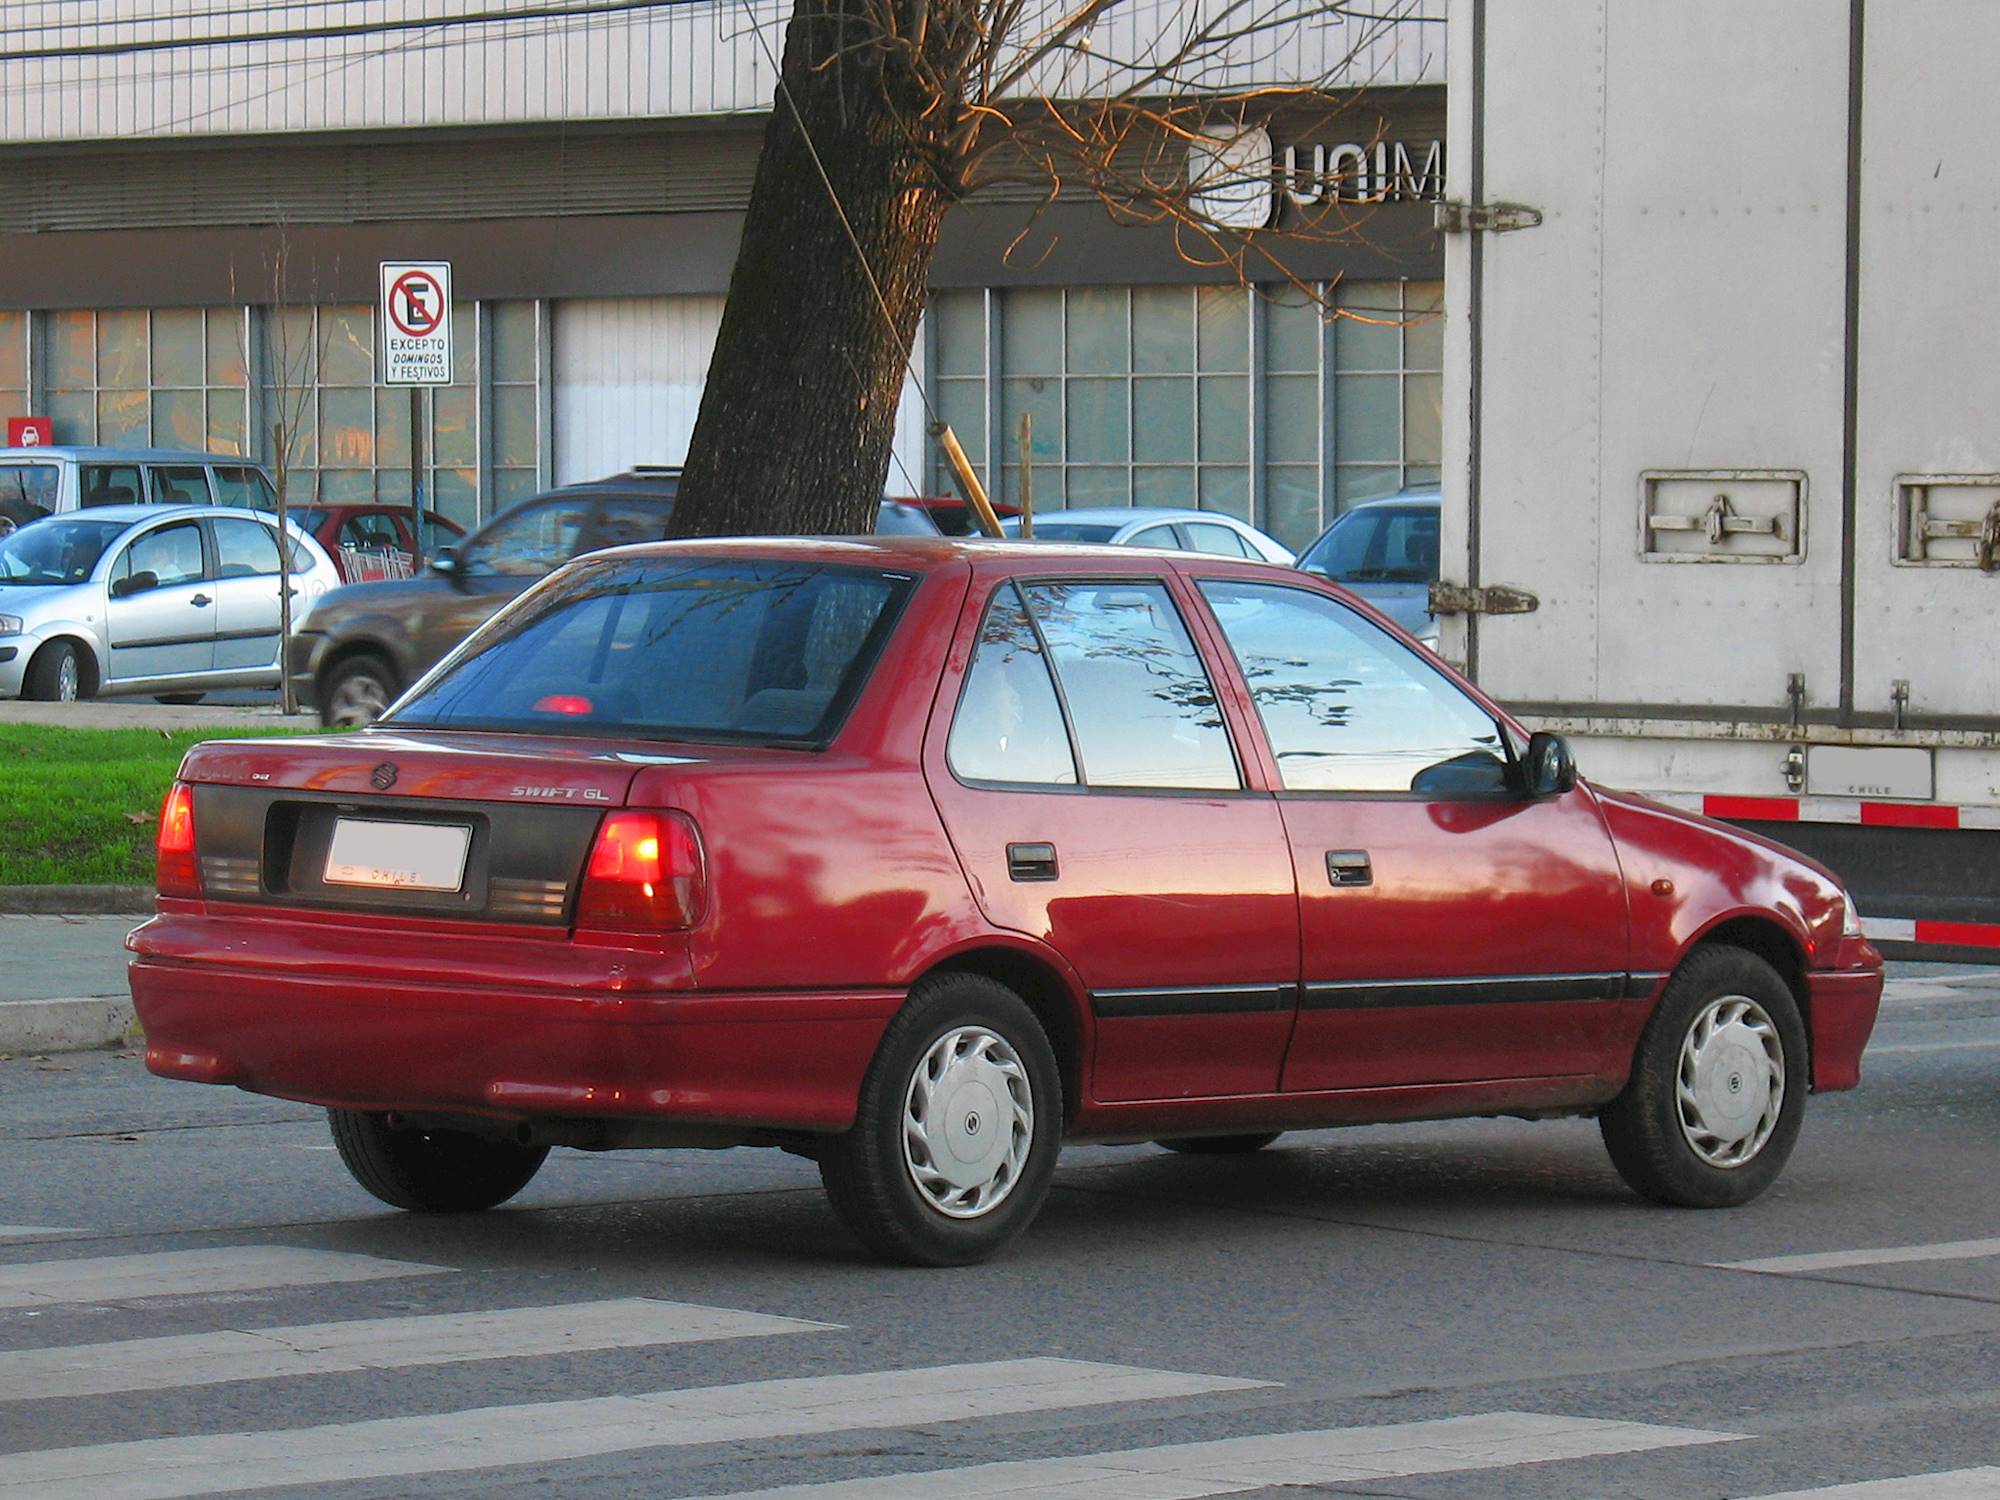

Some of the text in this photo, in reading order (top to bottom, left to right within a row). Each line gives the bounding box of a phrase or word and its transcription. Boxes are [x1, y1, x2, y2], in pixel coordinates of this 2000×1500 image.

[390, 338, 445, 351] EXCEPTO
[393, 353, 443, 364] DOMINGOS
[391, 366, 446, 378] Y FESTIVOS
[510, 786, 610, 801] SWIFT GL
[1848, 785, 1891, 795] CHILE
[371, 868, 417, 884] CHILE
